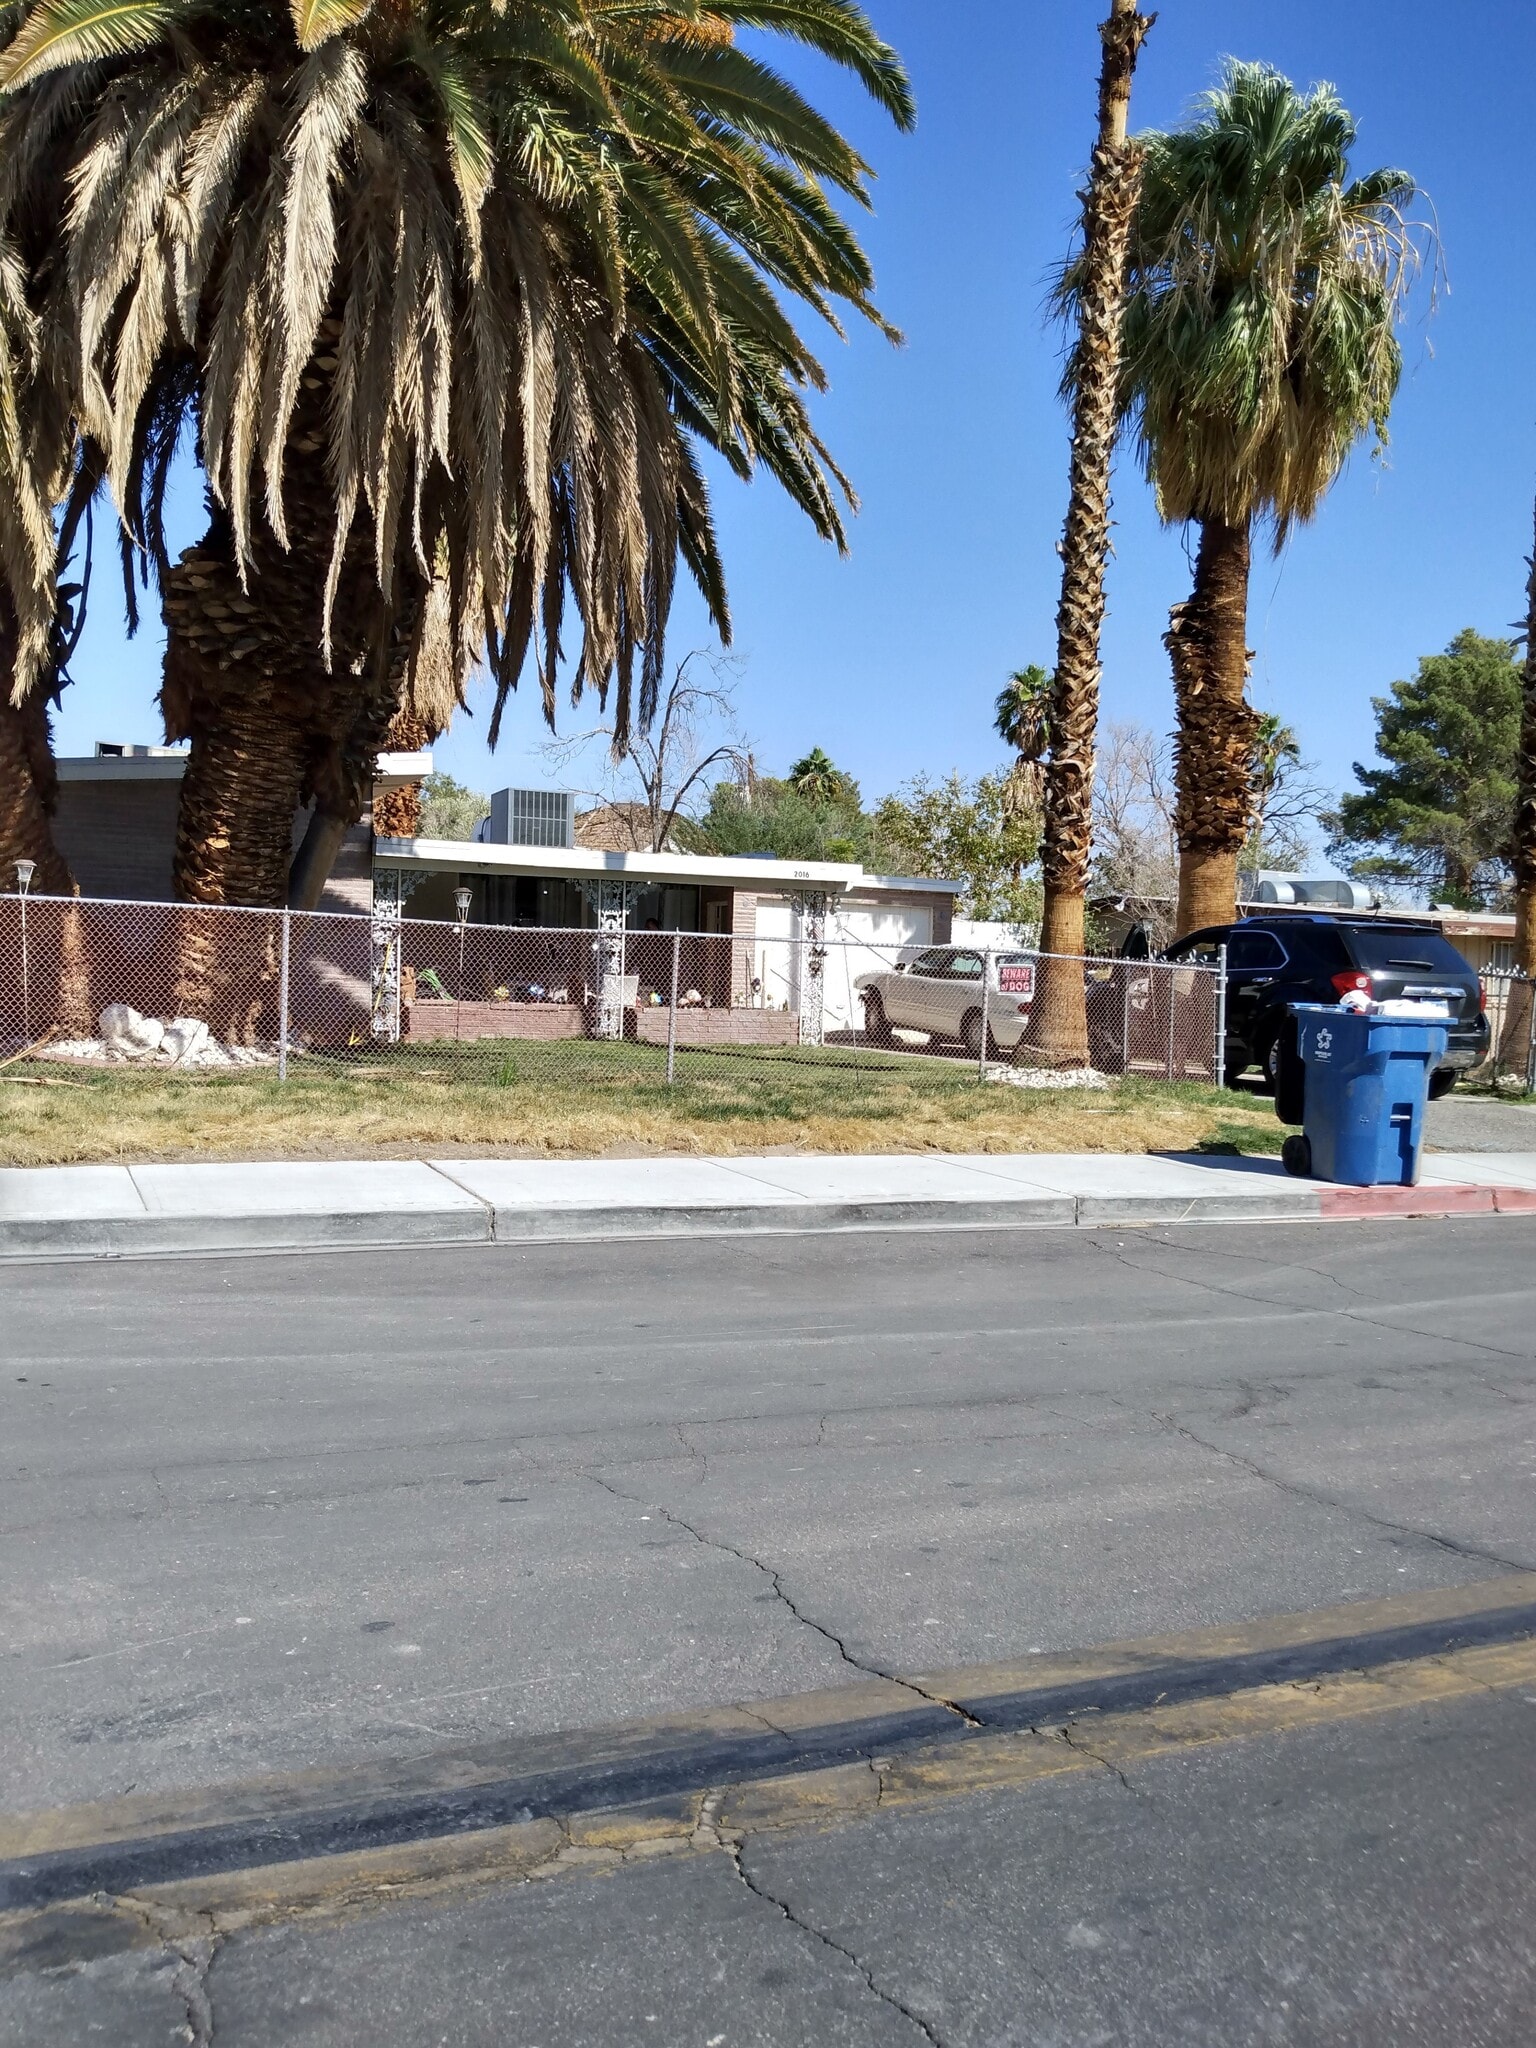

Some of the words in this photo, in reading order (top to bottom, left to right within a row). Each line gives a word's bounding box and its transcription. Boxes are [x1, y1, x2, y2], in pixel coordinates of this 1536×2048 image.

[794, 870, 810, 878] 2016
[1002, 968, 1030, 979] BEWARE
[1009, 981, 1030, 991] DOG
